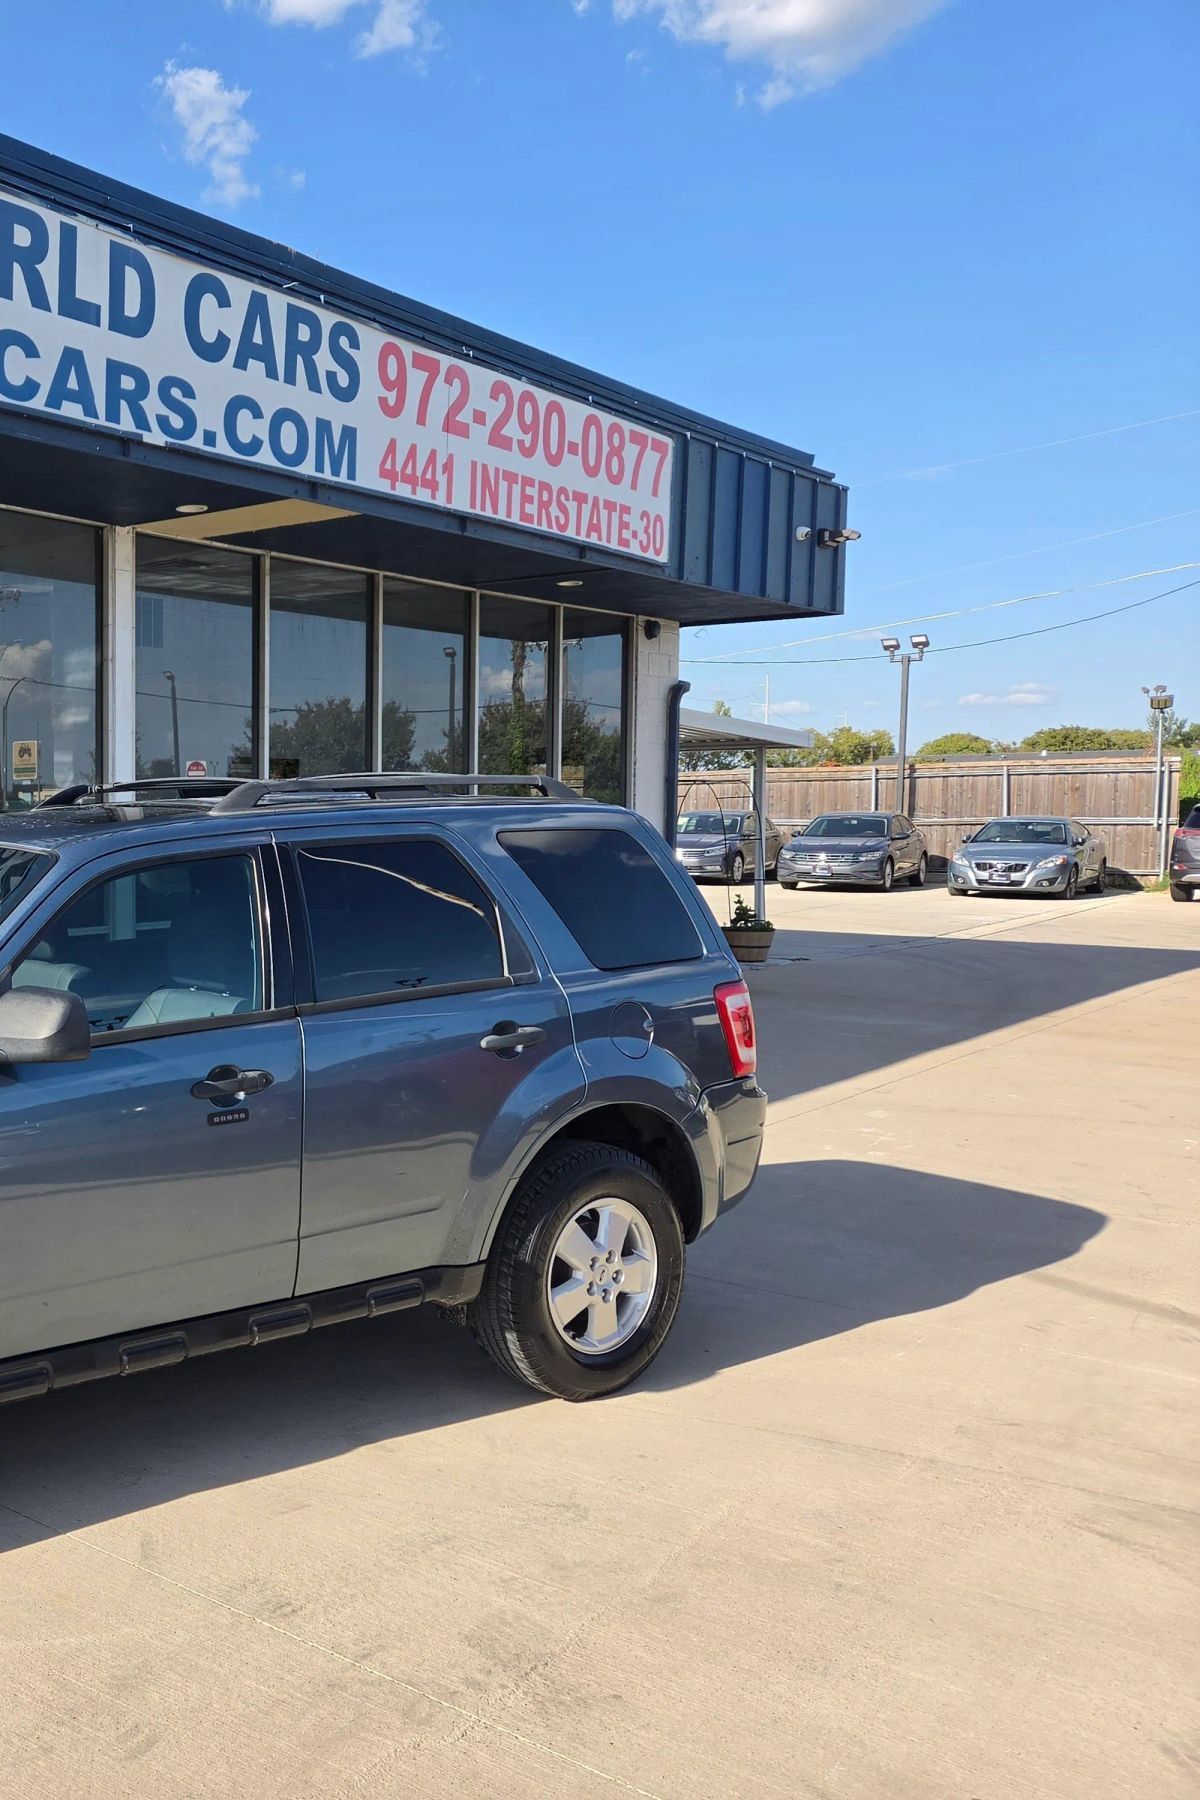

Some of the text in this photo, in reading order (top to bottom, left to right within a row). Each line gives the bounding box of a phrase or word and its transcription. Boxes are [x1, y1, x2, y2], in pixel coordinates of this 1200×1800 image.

[183, 273, 361, 403] CARS
[377, 341, 669, 498] 972-290-0877
[378, 438, 665, 557] 4441 INTERSTATE-30
